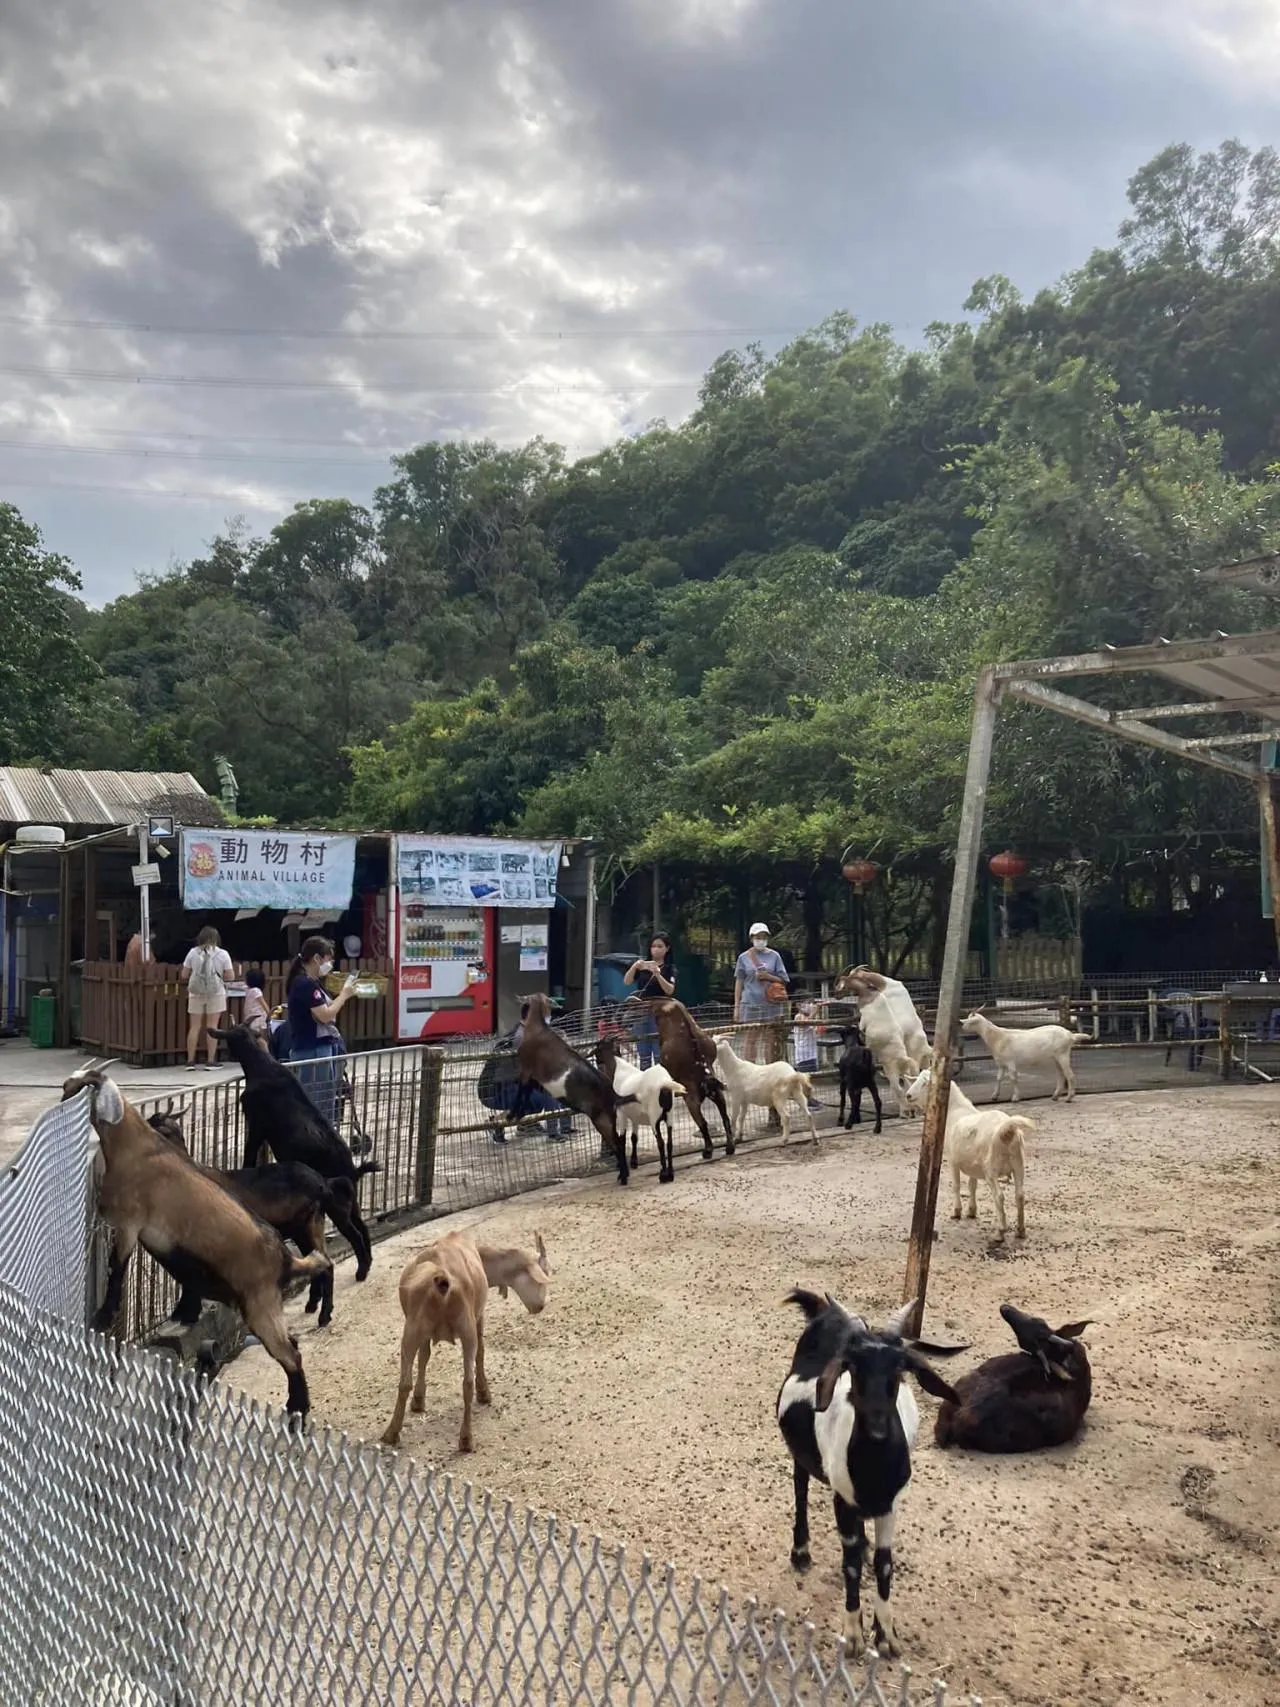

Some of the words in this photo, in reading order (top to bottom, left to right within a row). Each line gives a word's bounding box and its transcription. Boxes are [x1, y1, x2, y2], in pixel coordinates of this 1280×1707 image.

[220, 838, 327, 866] 動物村
[218, 869, 266, 882] ANIMAL
[273, 871, 326, 883] VILLAGE
